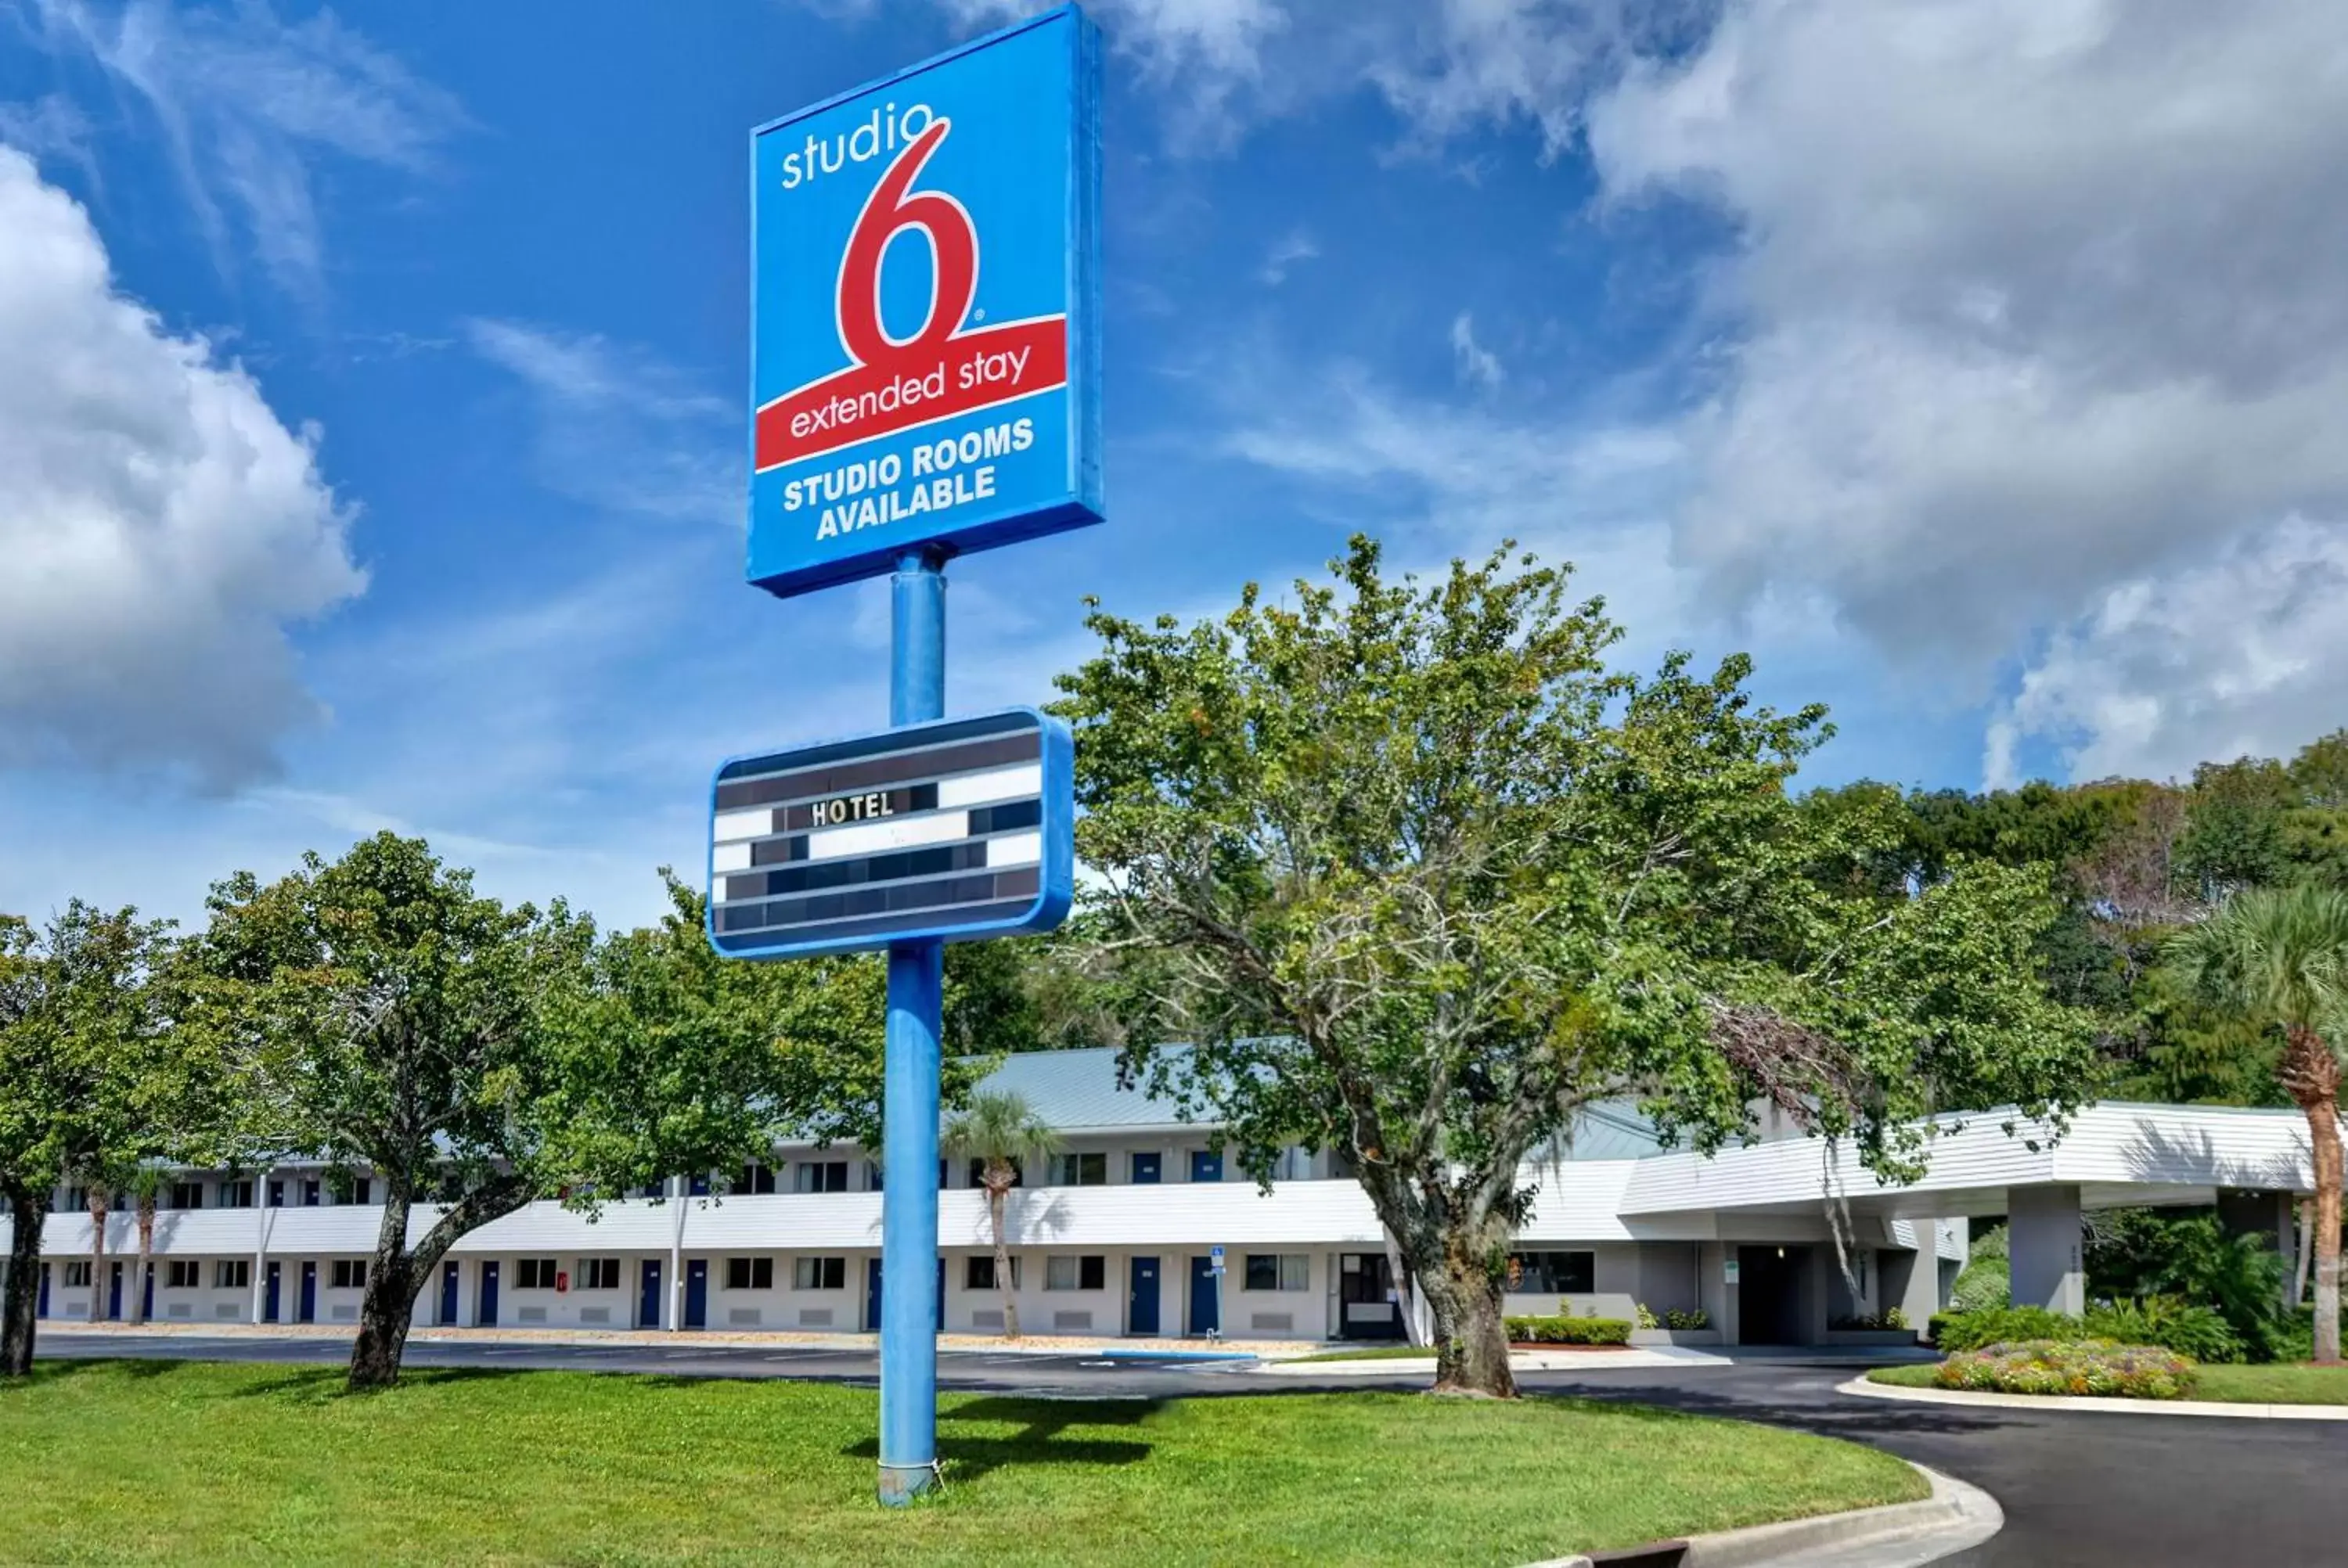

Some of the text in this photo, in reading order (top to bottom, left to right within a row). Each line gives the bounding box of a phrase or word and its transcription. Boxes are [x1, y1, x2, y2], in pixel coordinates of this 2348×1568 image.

[782, 102, 933, 189] studio
[835, 117, 981, 369] 6
[790, 345, 1032, 439] extended stay
[783, 418, 1034, 512] STUDIO ROOMS
[816, 467, 996, 541] AVAILABLE
[812, 793, 894, 827] HOTEL
